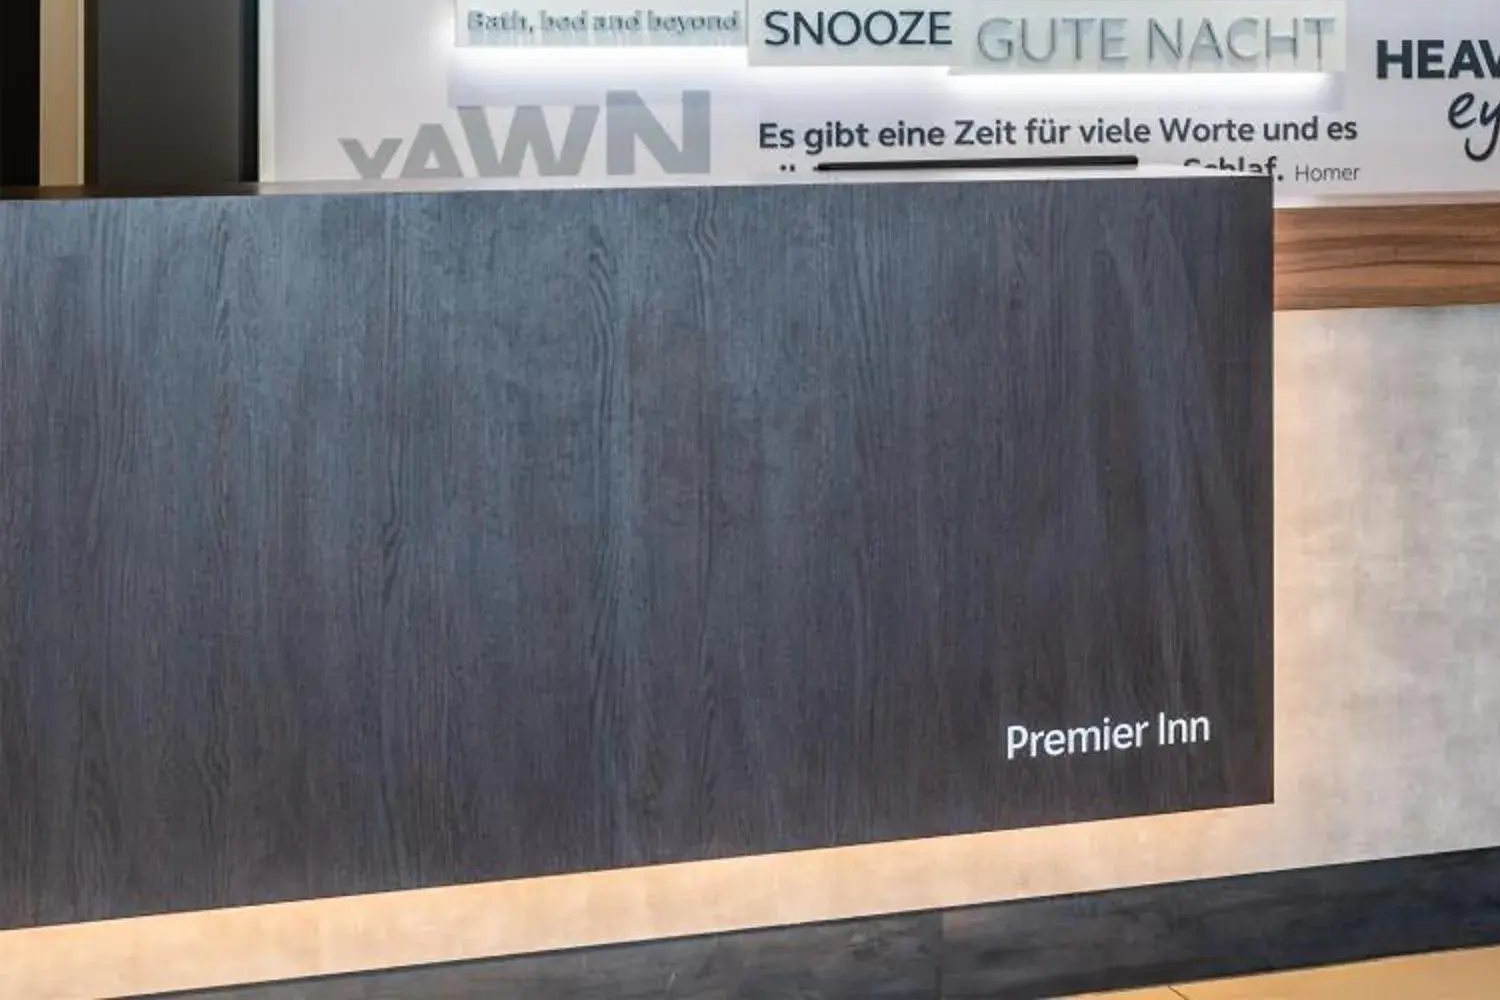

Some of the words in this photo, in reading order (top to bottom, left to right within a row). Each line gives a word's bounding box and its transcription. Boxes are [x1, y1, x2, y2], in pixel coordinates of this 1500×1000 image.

[593, 10, 640, 32] and
[648, 9, 740, 35] beyond
[764, 10, 953, 47] SNOOZE
[977, 16, 1129, 63] GUTE
[1147, 16, 1335, 67] NACHT
[759, 122, 795, 150] Es
[804, 122, 869, 154] gibt
[880, 121, 945, 146] eine
[955, 119, 1016, 145] Zeit
[1025, 117, 1071, 144] für
[1081, 118, 1150, 143] viele
[1159, 117, 1255, 142] Worte
[1263, 116, 1318, 141] und
[1328, 120, 1358, 140] es
[1295, 163, 1360, 182] Homer
[1007, 716, 1149, 760] Premier
[1159, 712, 1210, 745] Inn
